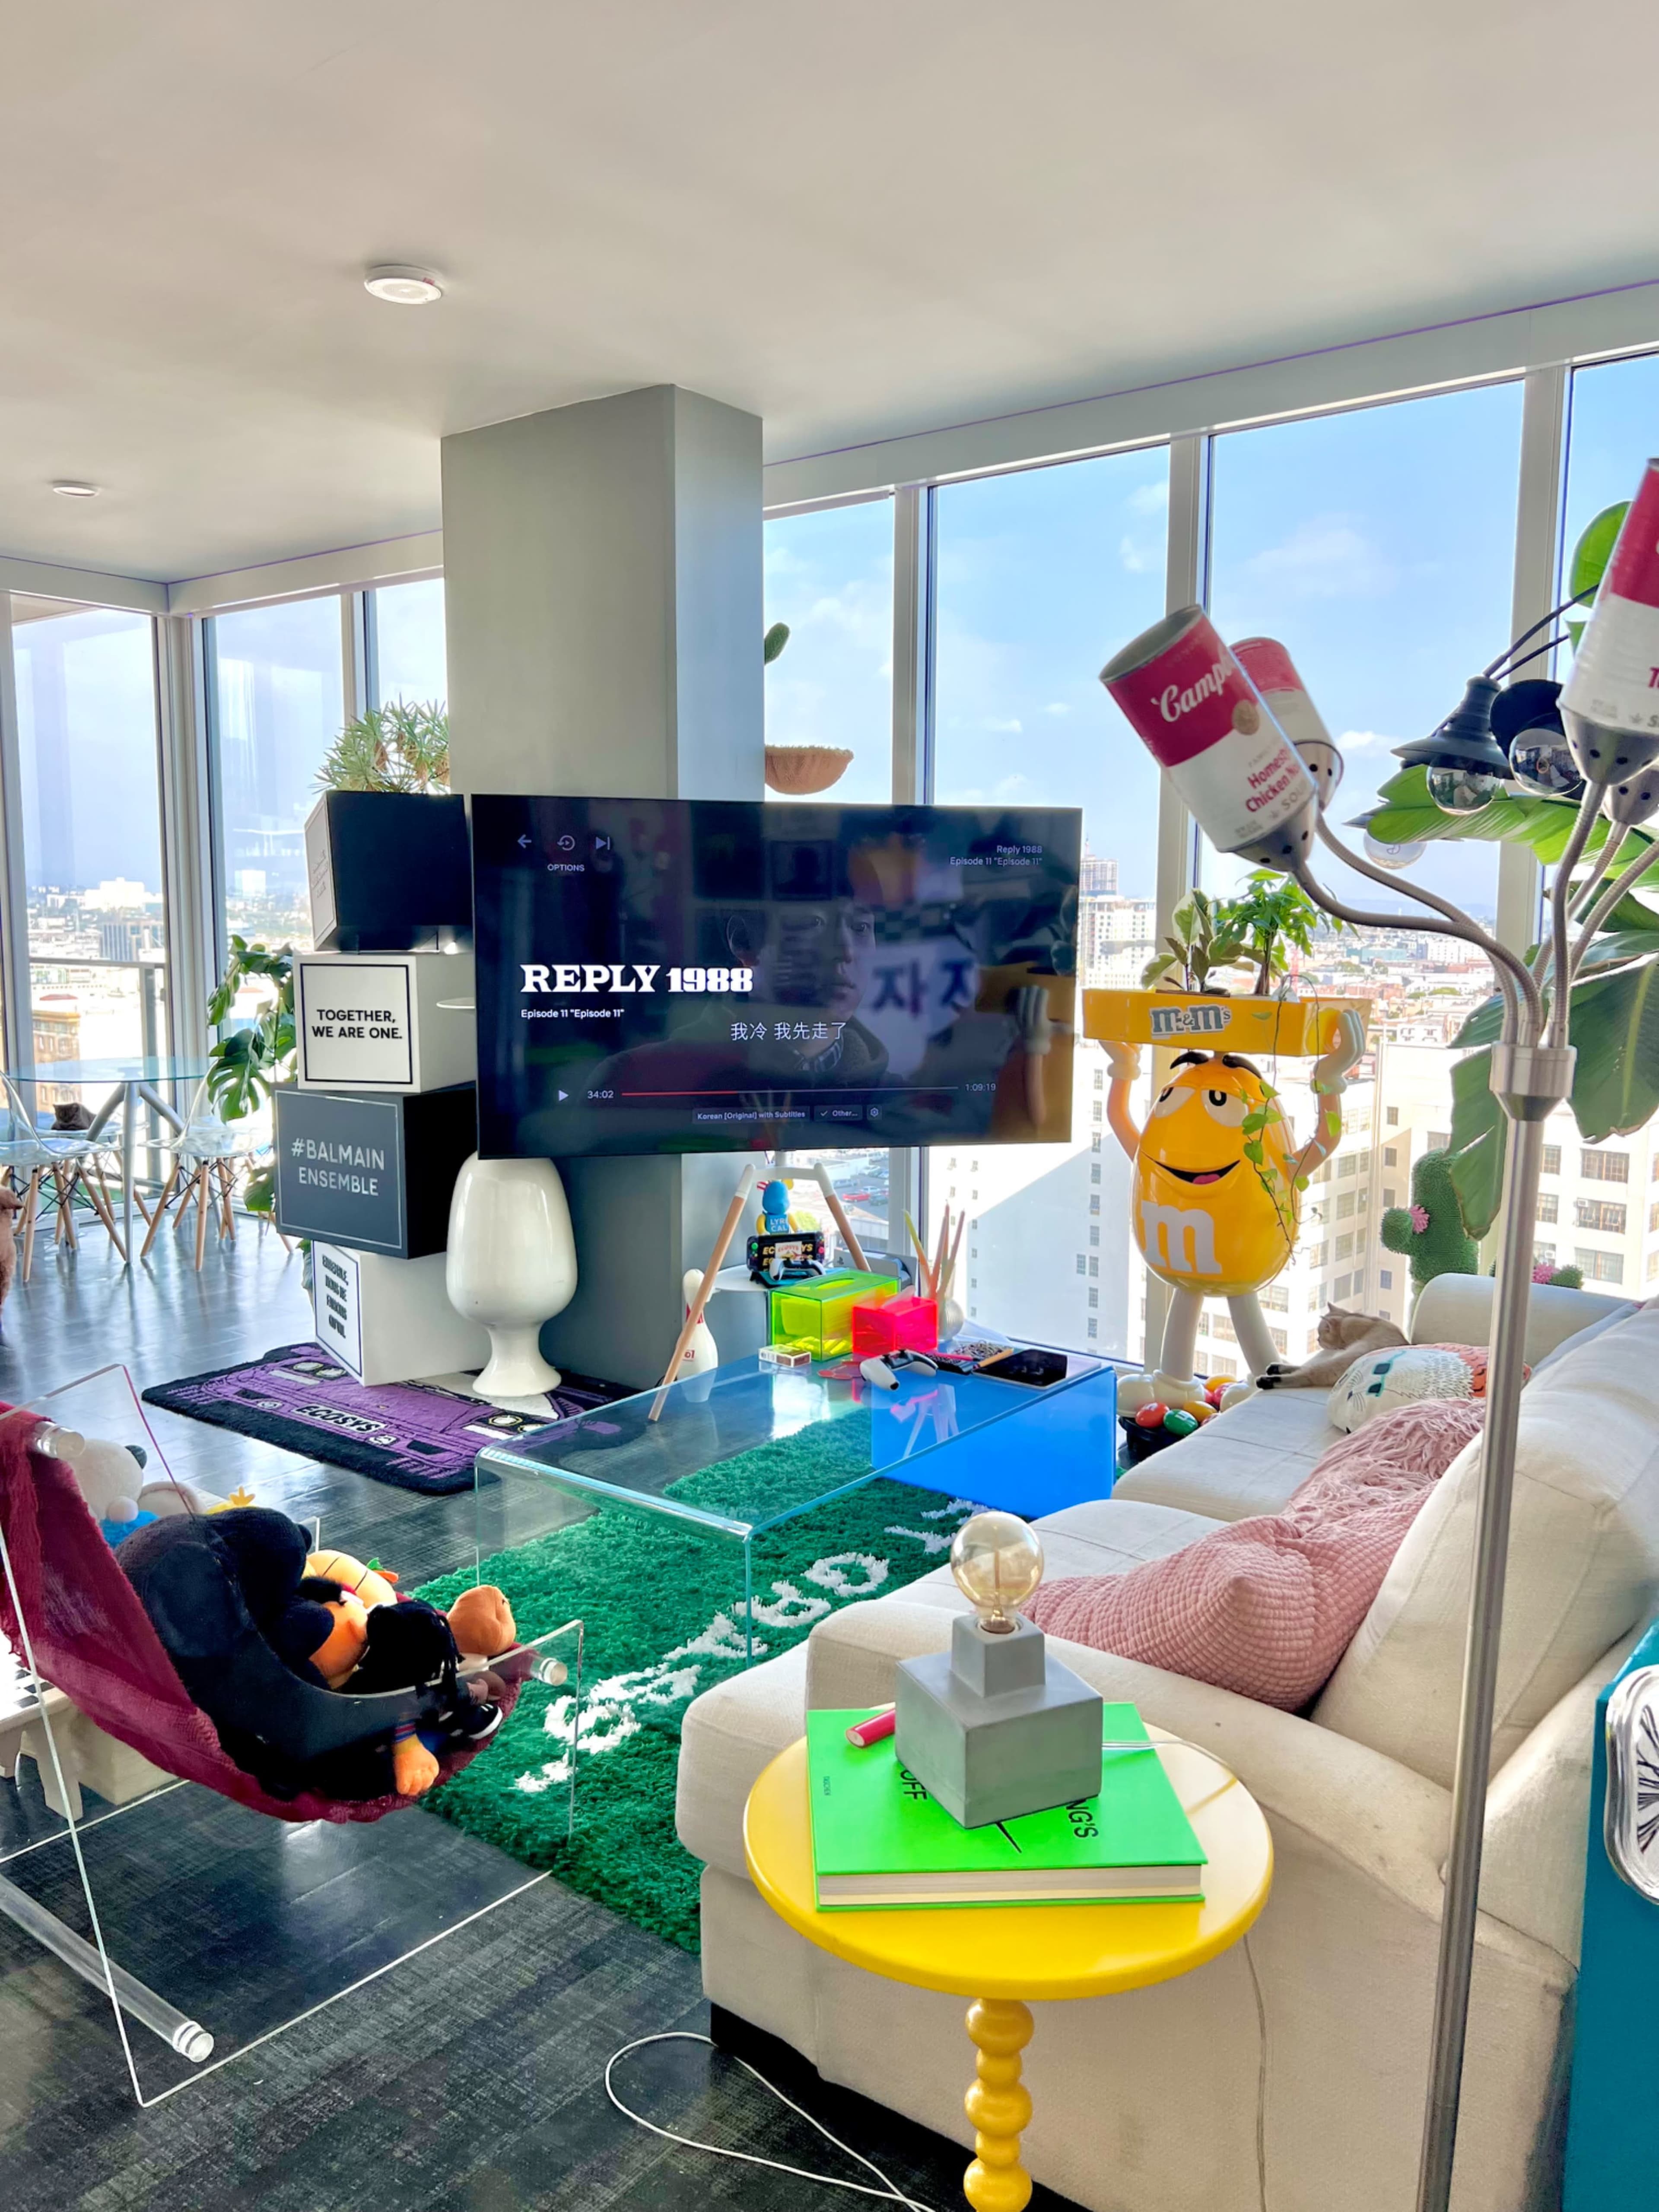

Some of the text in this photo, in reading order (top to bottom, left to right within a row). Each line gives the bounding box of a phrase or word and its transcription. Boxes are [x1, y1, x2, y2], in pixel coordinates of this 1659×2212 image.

[1246, 774, 1290, 813] Chicken
[997, 845, 1042, 855] Reply 1988
[950, 857, 983, 866] Episode
[985, 857, 992, 865] 11
[520, 964, 753, 992] REPLY 1988
[317, 1009, 397, 1023] TOGETHER,
[521, 1009, 558, 1019] Episode
[561, 1009, 568, 1017] 11
[311, 1027, 403, 1039] WE ARE ONE.
[731, 1021, 846, 1041] 我冷 我先走了
[965, 1083, 996, 1092] 1:09:19
[588, 1090, 613, 1099] 34:02
[724, 1112, 757, 1121] [Original]
[291, 1137, 385, 1170] #BALMAIN
[299, 1166, 379, 1197] ENSEMBLE
[295, 1405, 381, 1432] ECOSYS
